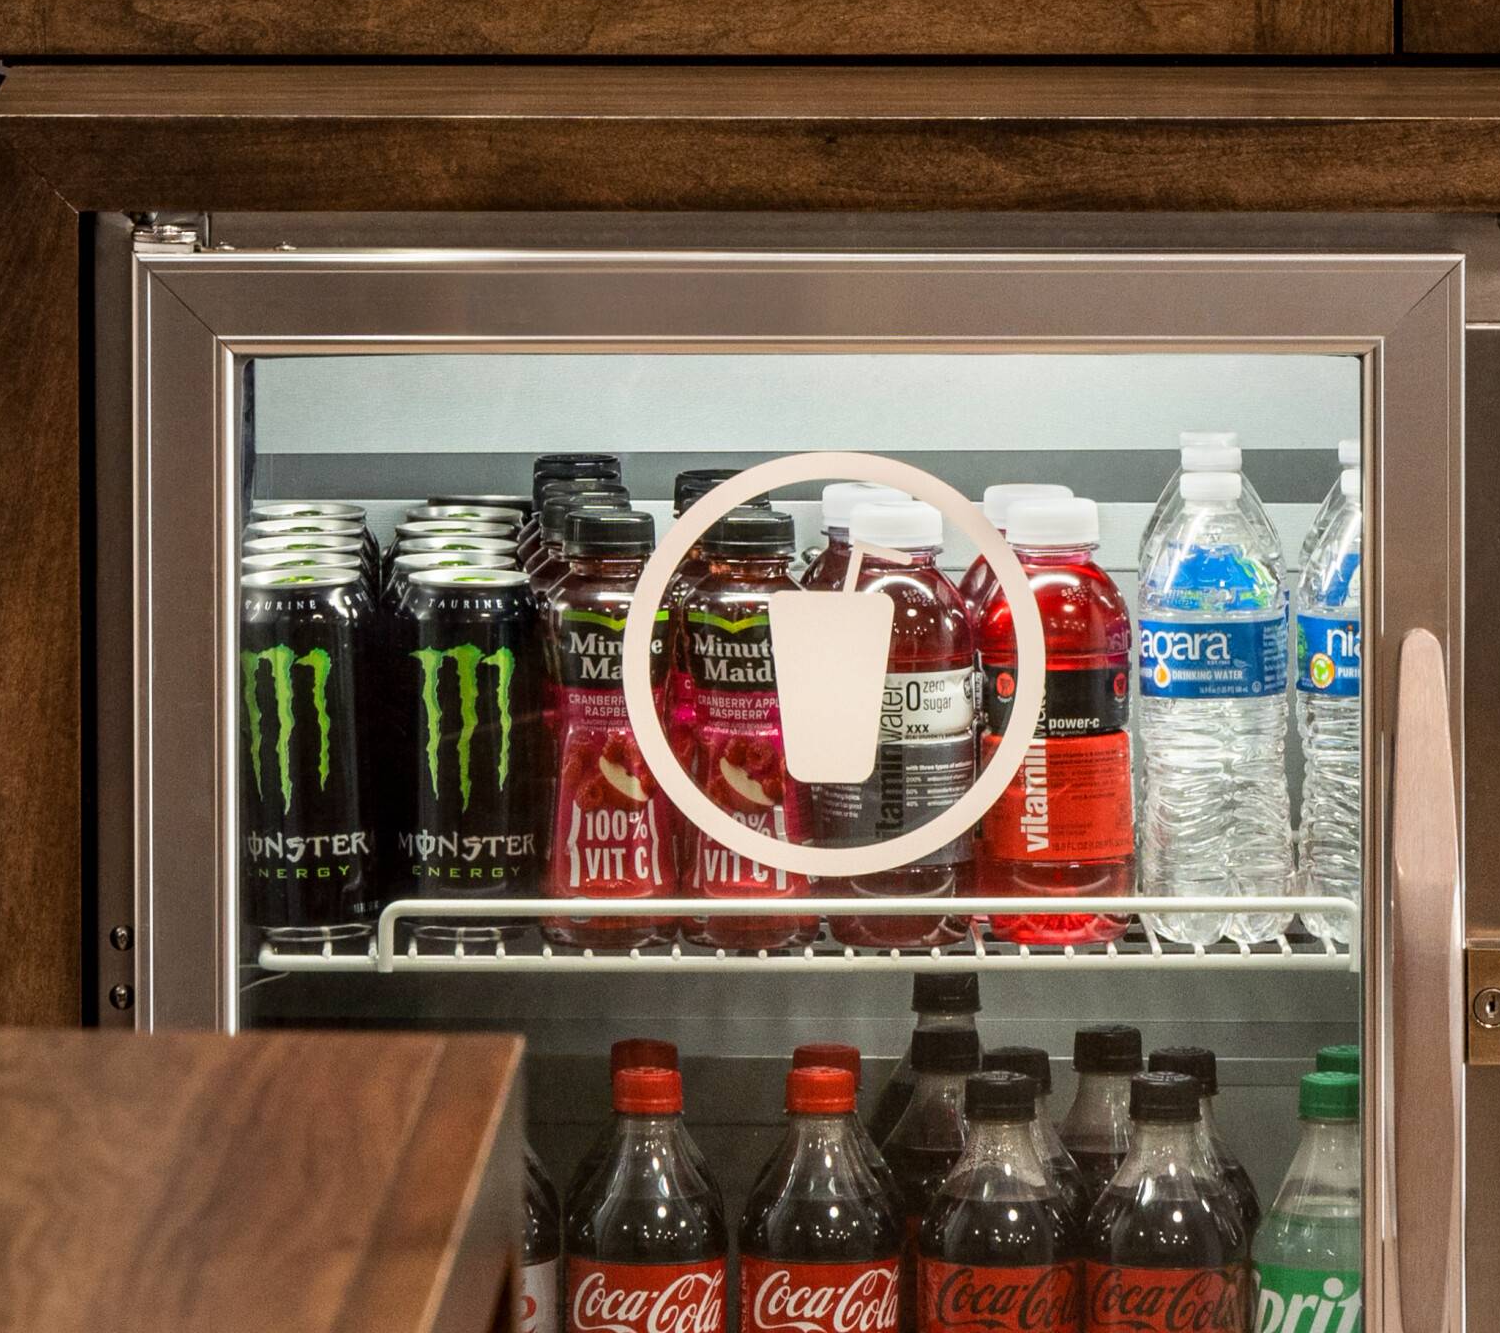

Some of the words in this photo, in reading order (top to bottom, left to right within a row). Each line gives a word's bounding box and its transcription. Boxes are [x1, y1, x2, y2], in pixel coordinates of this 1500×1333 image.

[704, 659, 774, 683] Maid
[1173, 670, 1212, 681] DRINKING
[1214, 671, 1243, 679] WATER
[923, 680, 945, 694] zero
[698, 695, 752, 709] CRANBERRY
[923, 692, 952, 713] sugar
[709, 707, 769, 720] RASPBERRY
[1048, 717, 1100, 729] power-c
[586, 809, 648, 841] 100%
[586, 847, 626, 880] VIT
[634, 847, 649, 879] C
[573, 1269, 723, 1333] Coca-Cola
